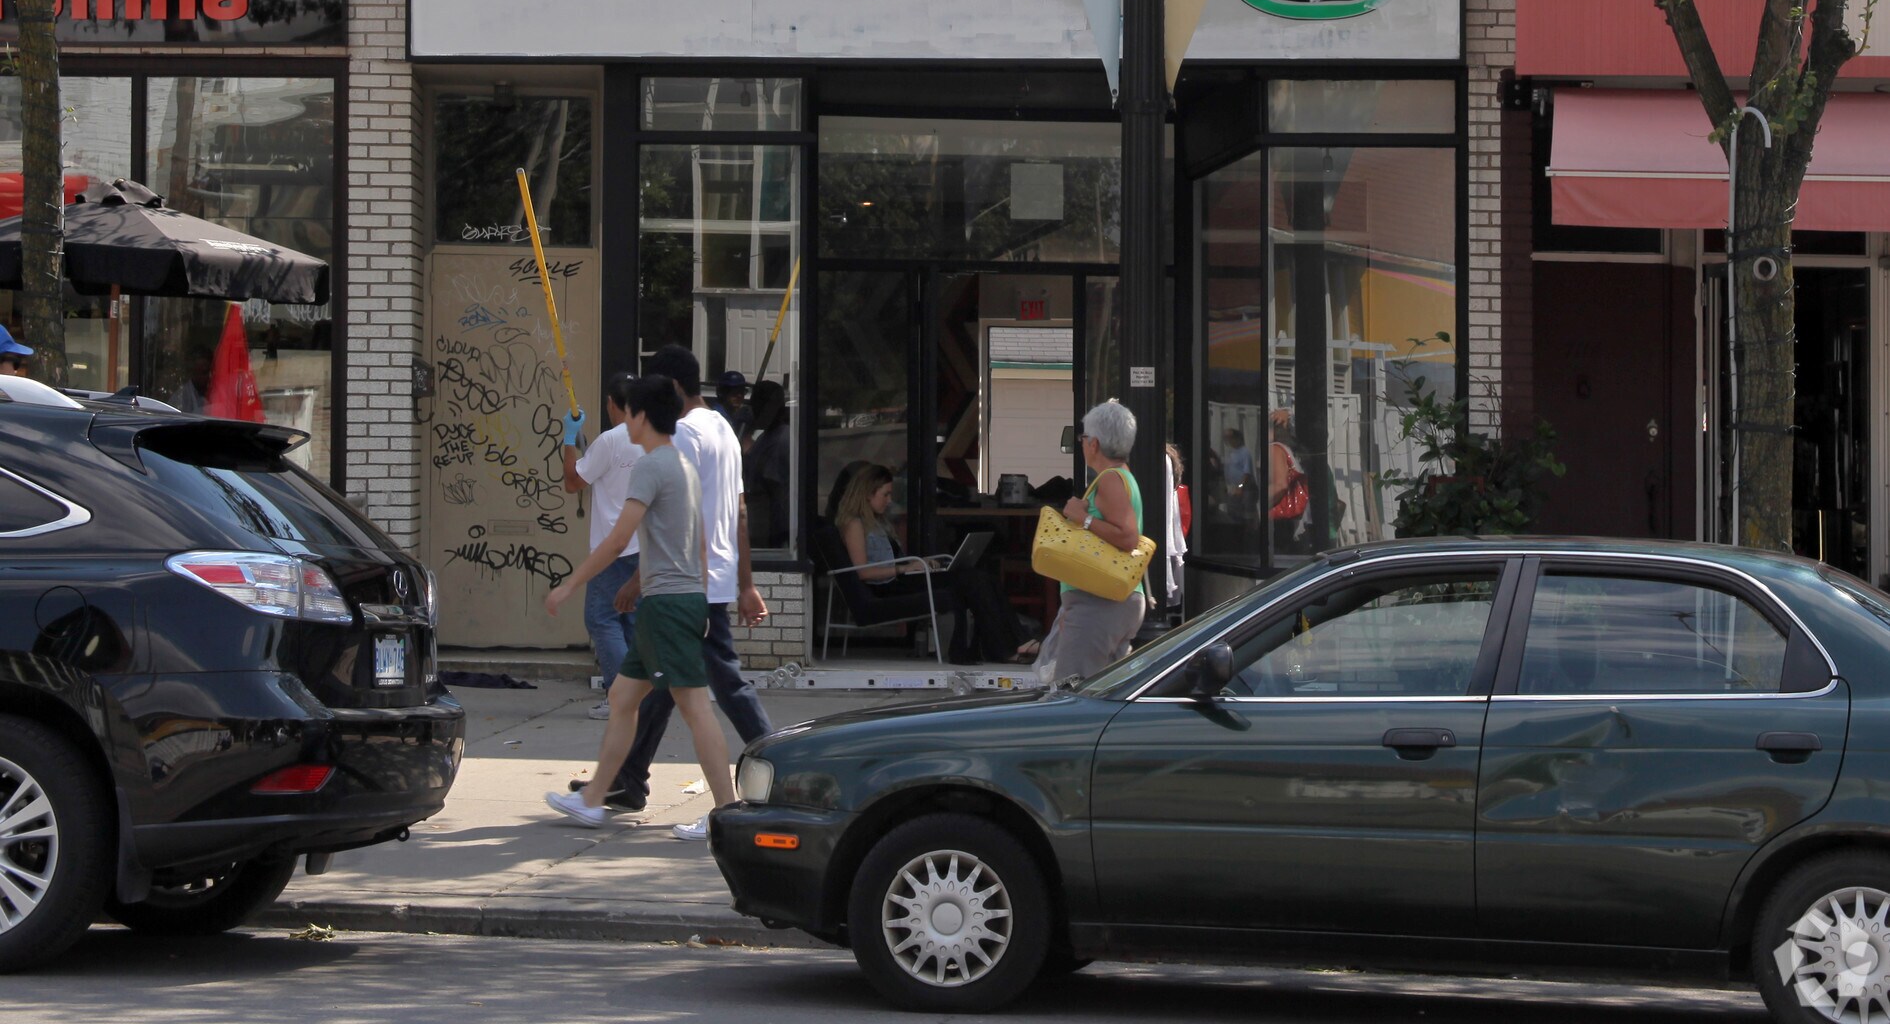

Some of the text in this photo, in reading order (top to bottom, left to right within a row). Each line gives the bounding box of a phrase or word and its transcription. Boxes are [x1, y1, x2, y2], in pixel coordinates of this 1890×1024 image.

[1021, 300, 1045, 320] EXIT
[439, 440, 469, 454] THE
[485, 444, 518, 466] 56
[433, 452, 474, 469] RE-UP
